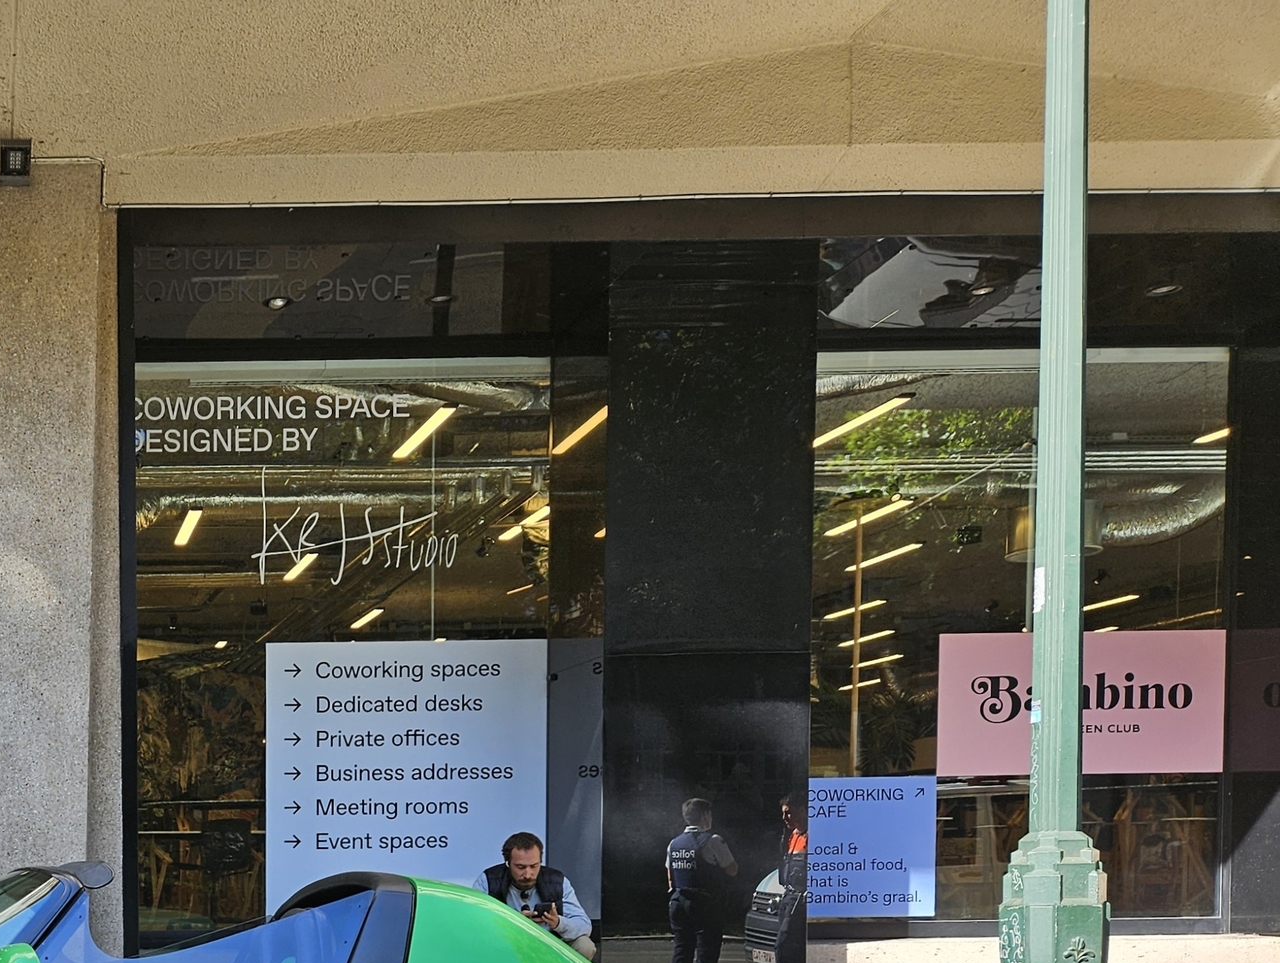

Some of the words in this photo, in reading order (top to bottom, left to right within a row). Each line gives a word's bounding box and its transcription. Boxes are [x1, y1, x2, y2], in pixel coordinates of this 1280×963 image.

[315, 394, 410, 420] SPACE
[282, 428, 318, 452] BY
[315, 660, 424, 682] Coworking
[430, 663, 501, 682] spaces
[316, 694, 418, 714] Dedicated
[424, 693, 483, 712] desks
[971, 672, 1193, 724] Bbino
[316, 730, 385, 748] Private
[391, 728, 460, 747] offices
[1107, 723, 1141, 734] CLUB
[316, 764, 405, 782] Business
[411, 762, 514, 781] addresses
[808, 788, 904, 803] COWORKING
[316, 797, 398, 820] Meeting
[405, 801, 469, 815] rooms
[808, 802, 847, 819] CAFÉ
[315, 832, 373, 850] Event
[378, 835, 449, 854] spaces
[847, 842, 859, 855] &
[870, 857, 908, 873] food,
[837, 874, 849, 888] is
[882, 890, 922, 907] graal.
